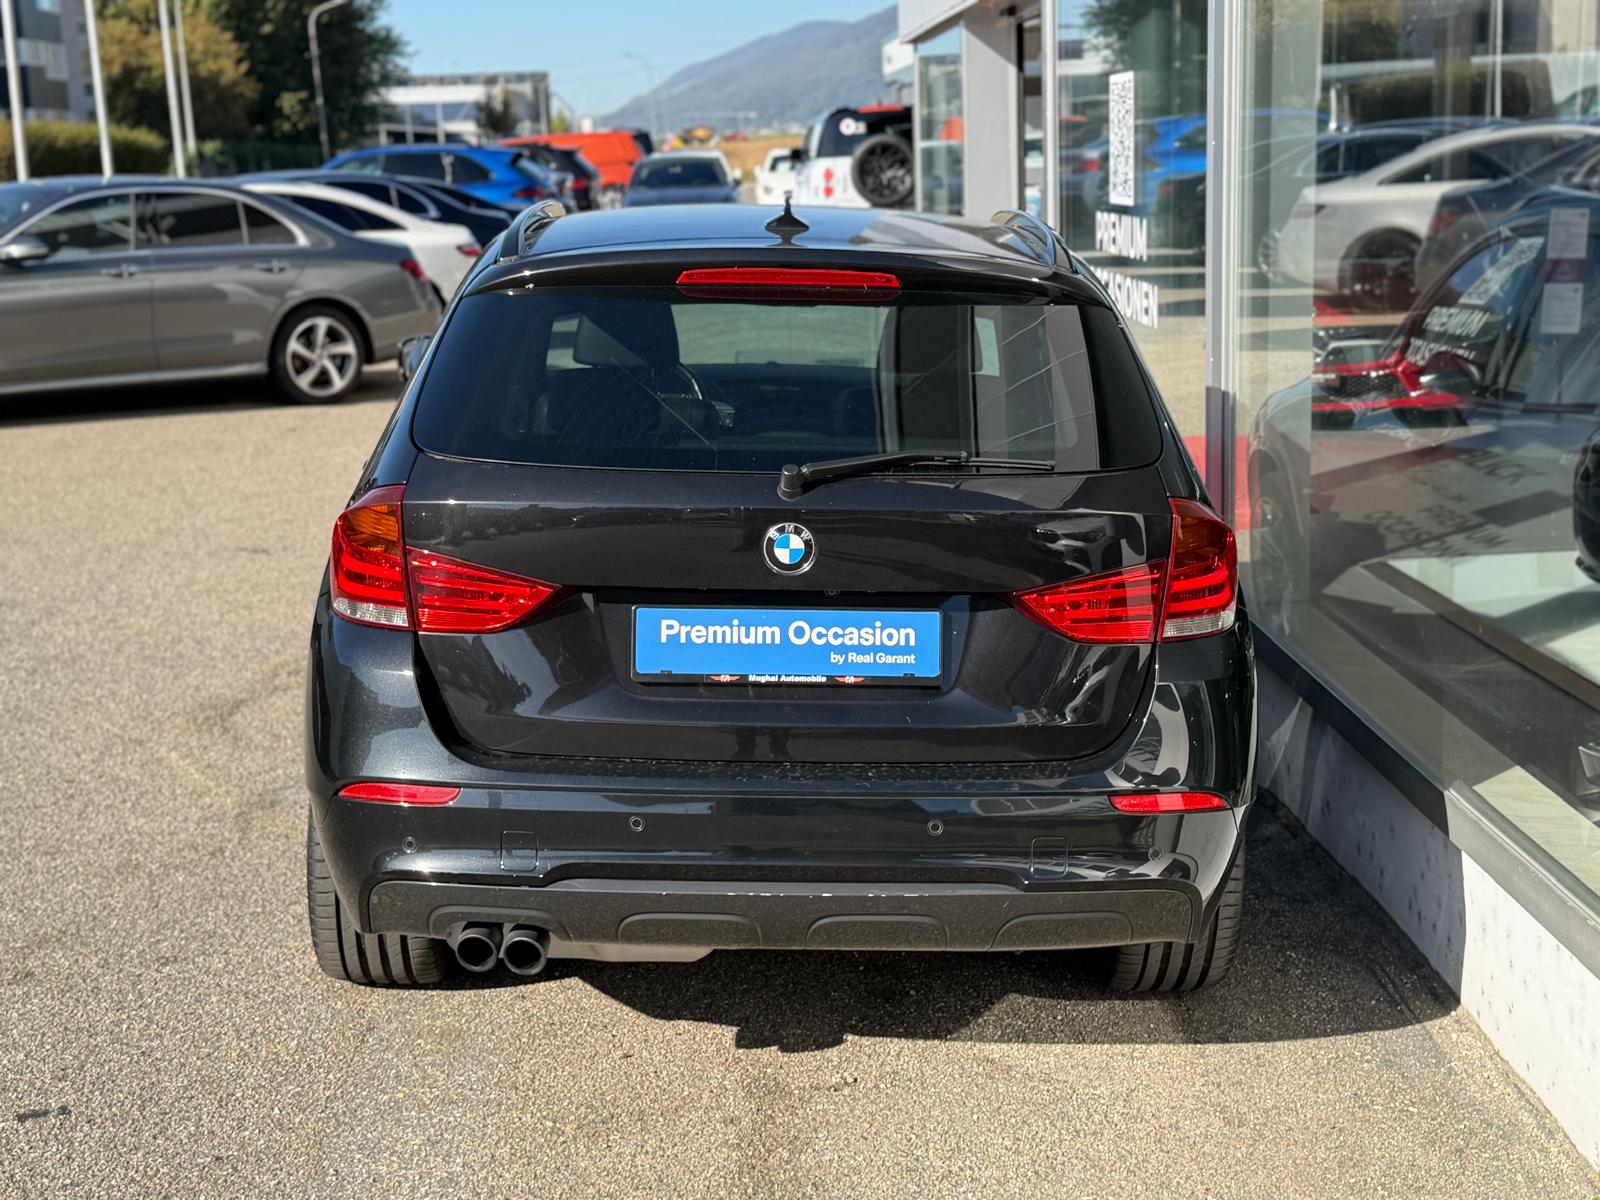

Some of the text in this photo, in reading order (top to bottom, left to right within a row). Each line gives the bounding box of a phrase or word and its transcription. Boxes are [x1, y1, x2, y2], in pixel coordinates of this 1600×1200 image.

[1095, 210, 1147, 262] PREMIUM
[1089, 265, 1158, 328] ASIONEN
[660, 618, 916, 647] Premium Occasion
[830, 652, 915, 664] by Real Garant
[748, 674, 827, 683] Mughal Automobile
